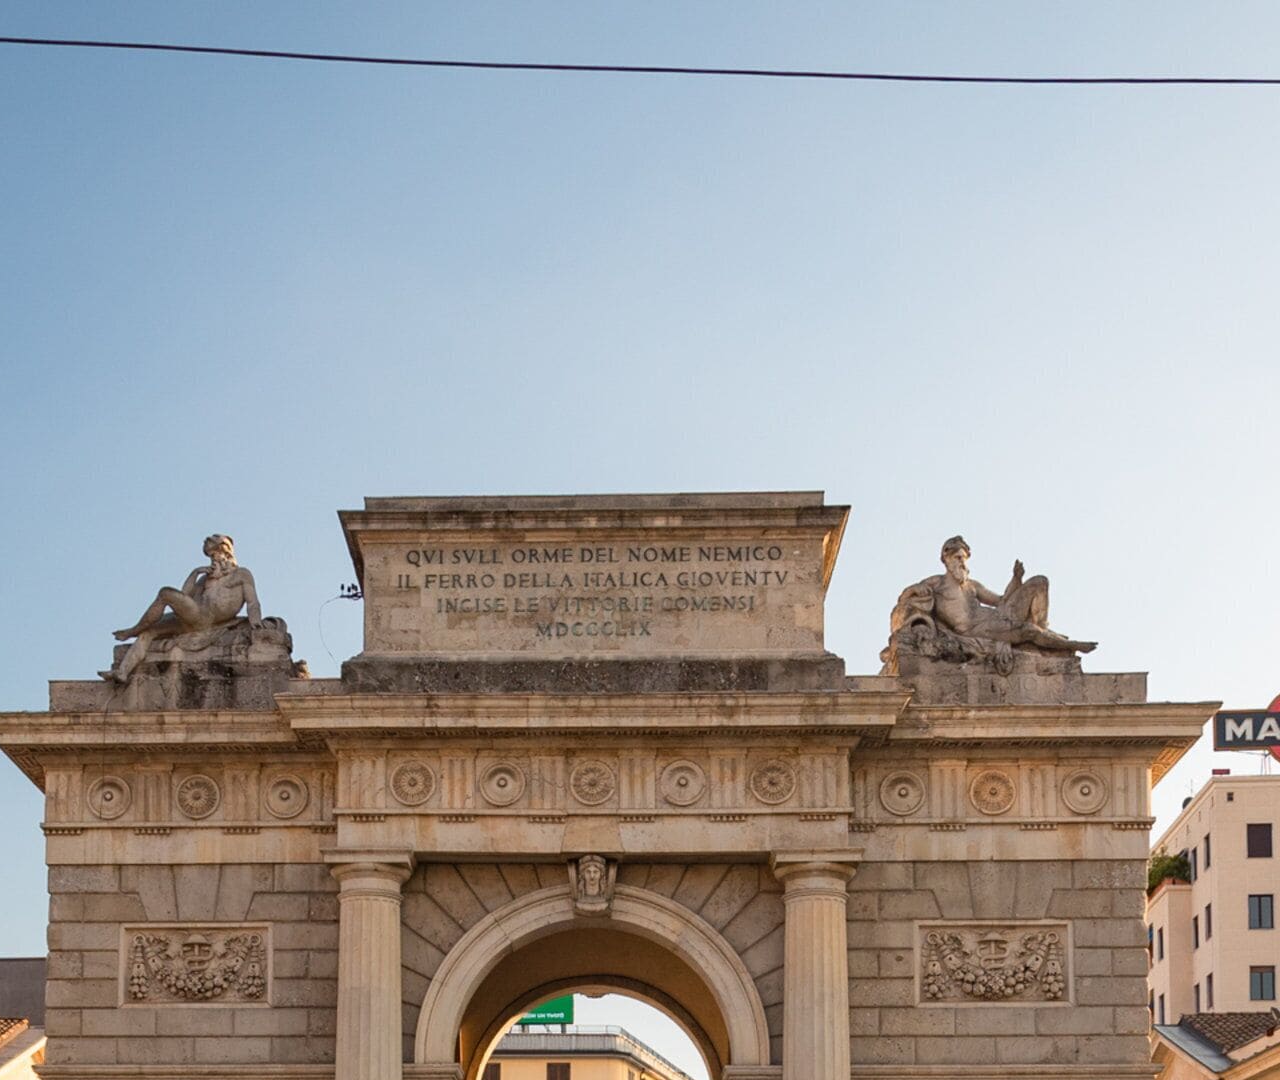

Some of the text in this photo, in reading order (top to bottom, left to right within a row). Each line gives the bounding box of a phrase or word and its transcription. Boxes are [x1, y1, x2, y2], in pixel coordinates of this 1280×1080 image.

[406, 546, 783, 567] QVI SVLL ORME DEL NOME NEMICO
[397, 570, 789, 589] IL FERRO DELLA ITALICA GIOVENTV
[437, 595, 755, 613] INCISE LE VITTORIE COMENSI
[535, 621, 653, 637] MDCCCLIX
